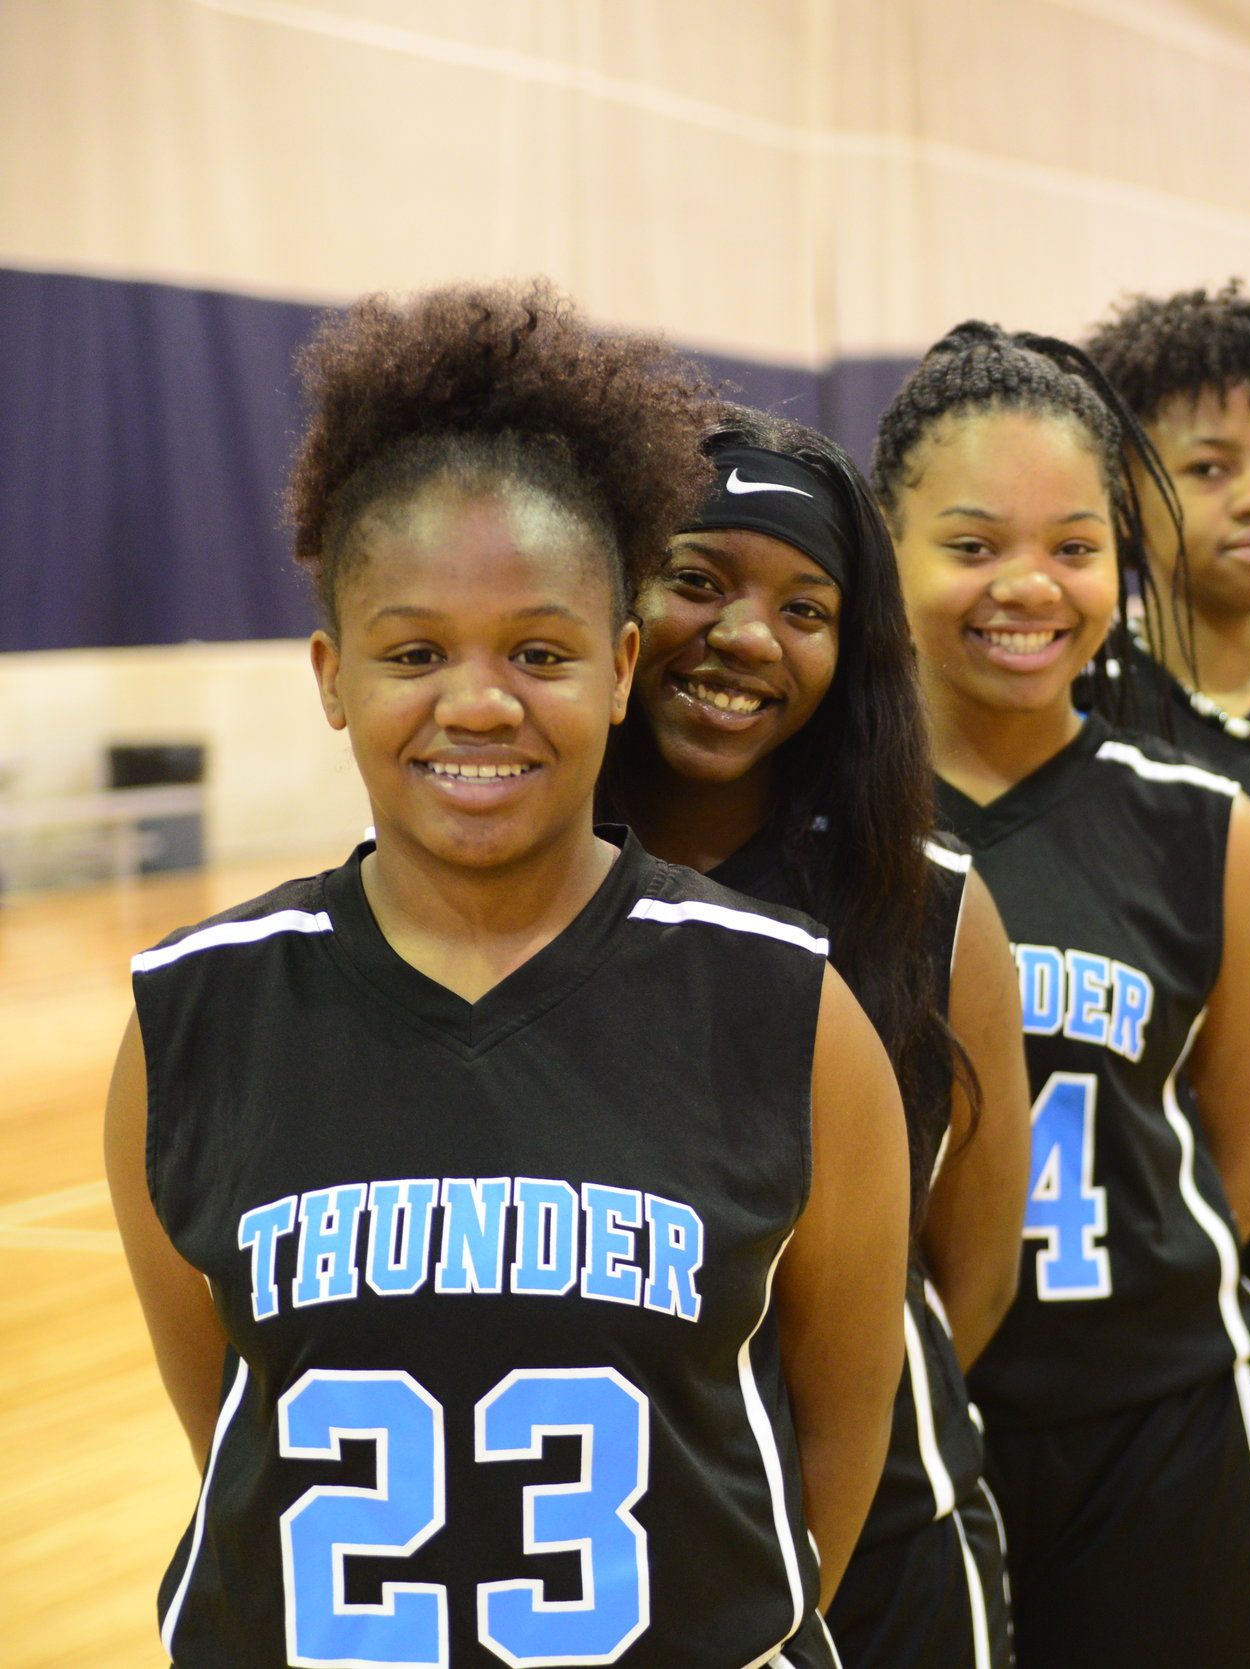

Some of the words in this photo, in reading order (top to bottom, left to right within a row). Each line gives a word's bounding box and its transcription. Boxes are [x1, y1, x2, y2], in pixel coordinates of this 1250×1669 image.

[1009, 942, 1154, 1063] DER
[238, 1177, 703, 1322] THUNDER
[1022, 1071, 1112, 1300] 4
[277, 1366, 650, 1669] 23
